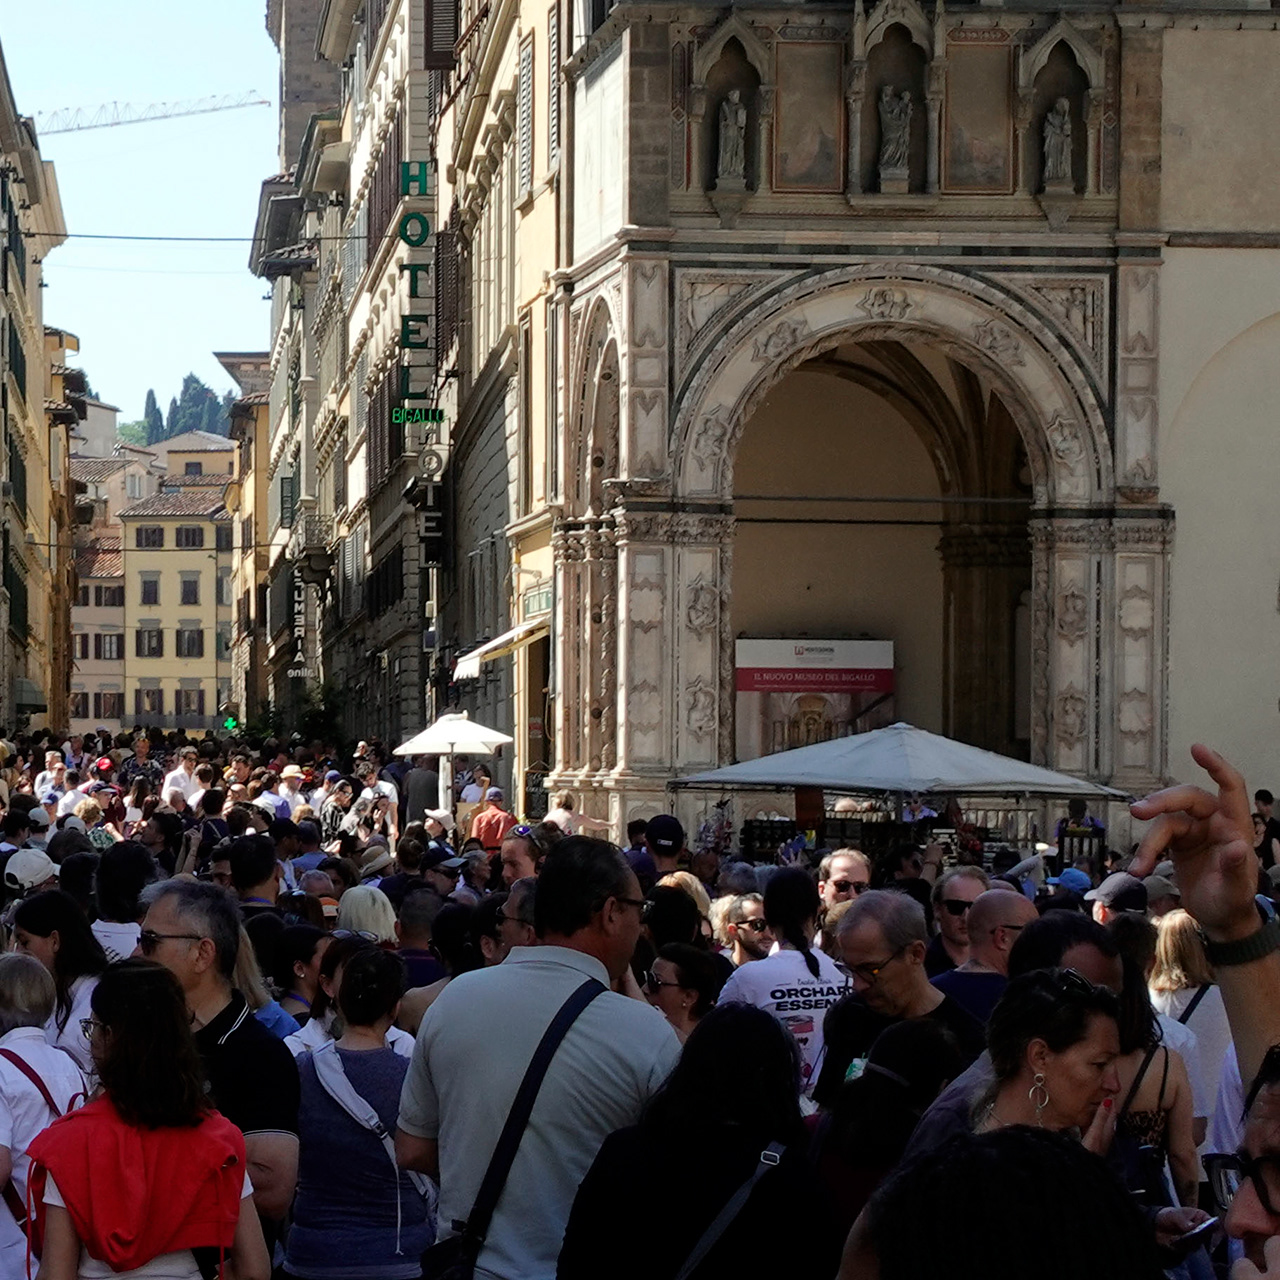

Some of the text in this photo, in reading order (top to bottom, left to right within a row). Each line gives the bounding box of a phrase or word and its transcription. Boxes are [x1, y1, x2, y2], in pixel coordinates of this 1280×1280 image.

[400, 161, 430, 400] HOTEL
[392, 408, 444, 423] BIGALLO
[794, 673, 823, 681] MUSEO
